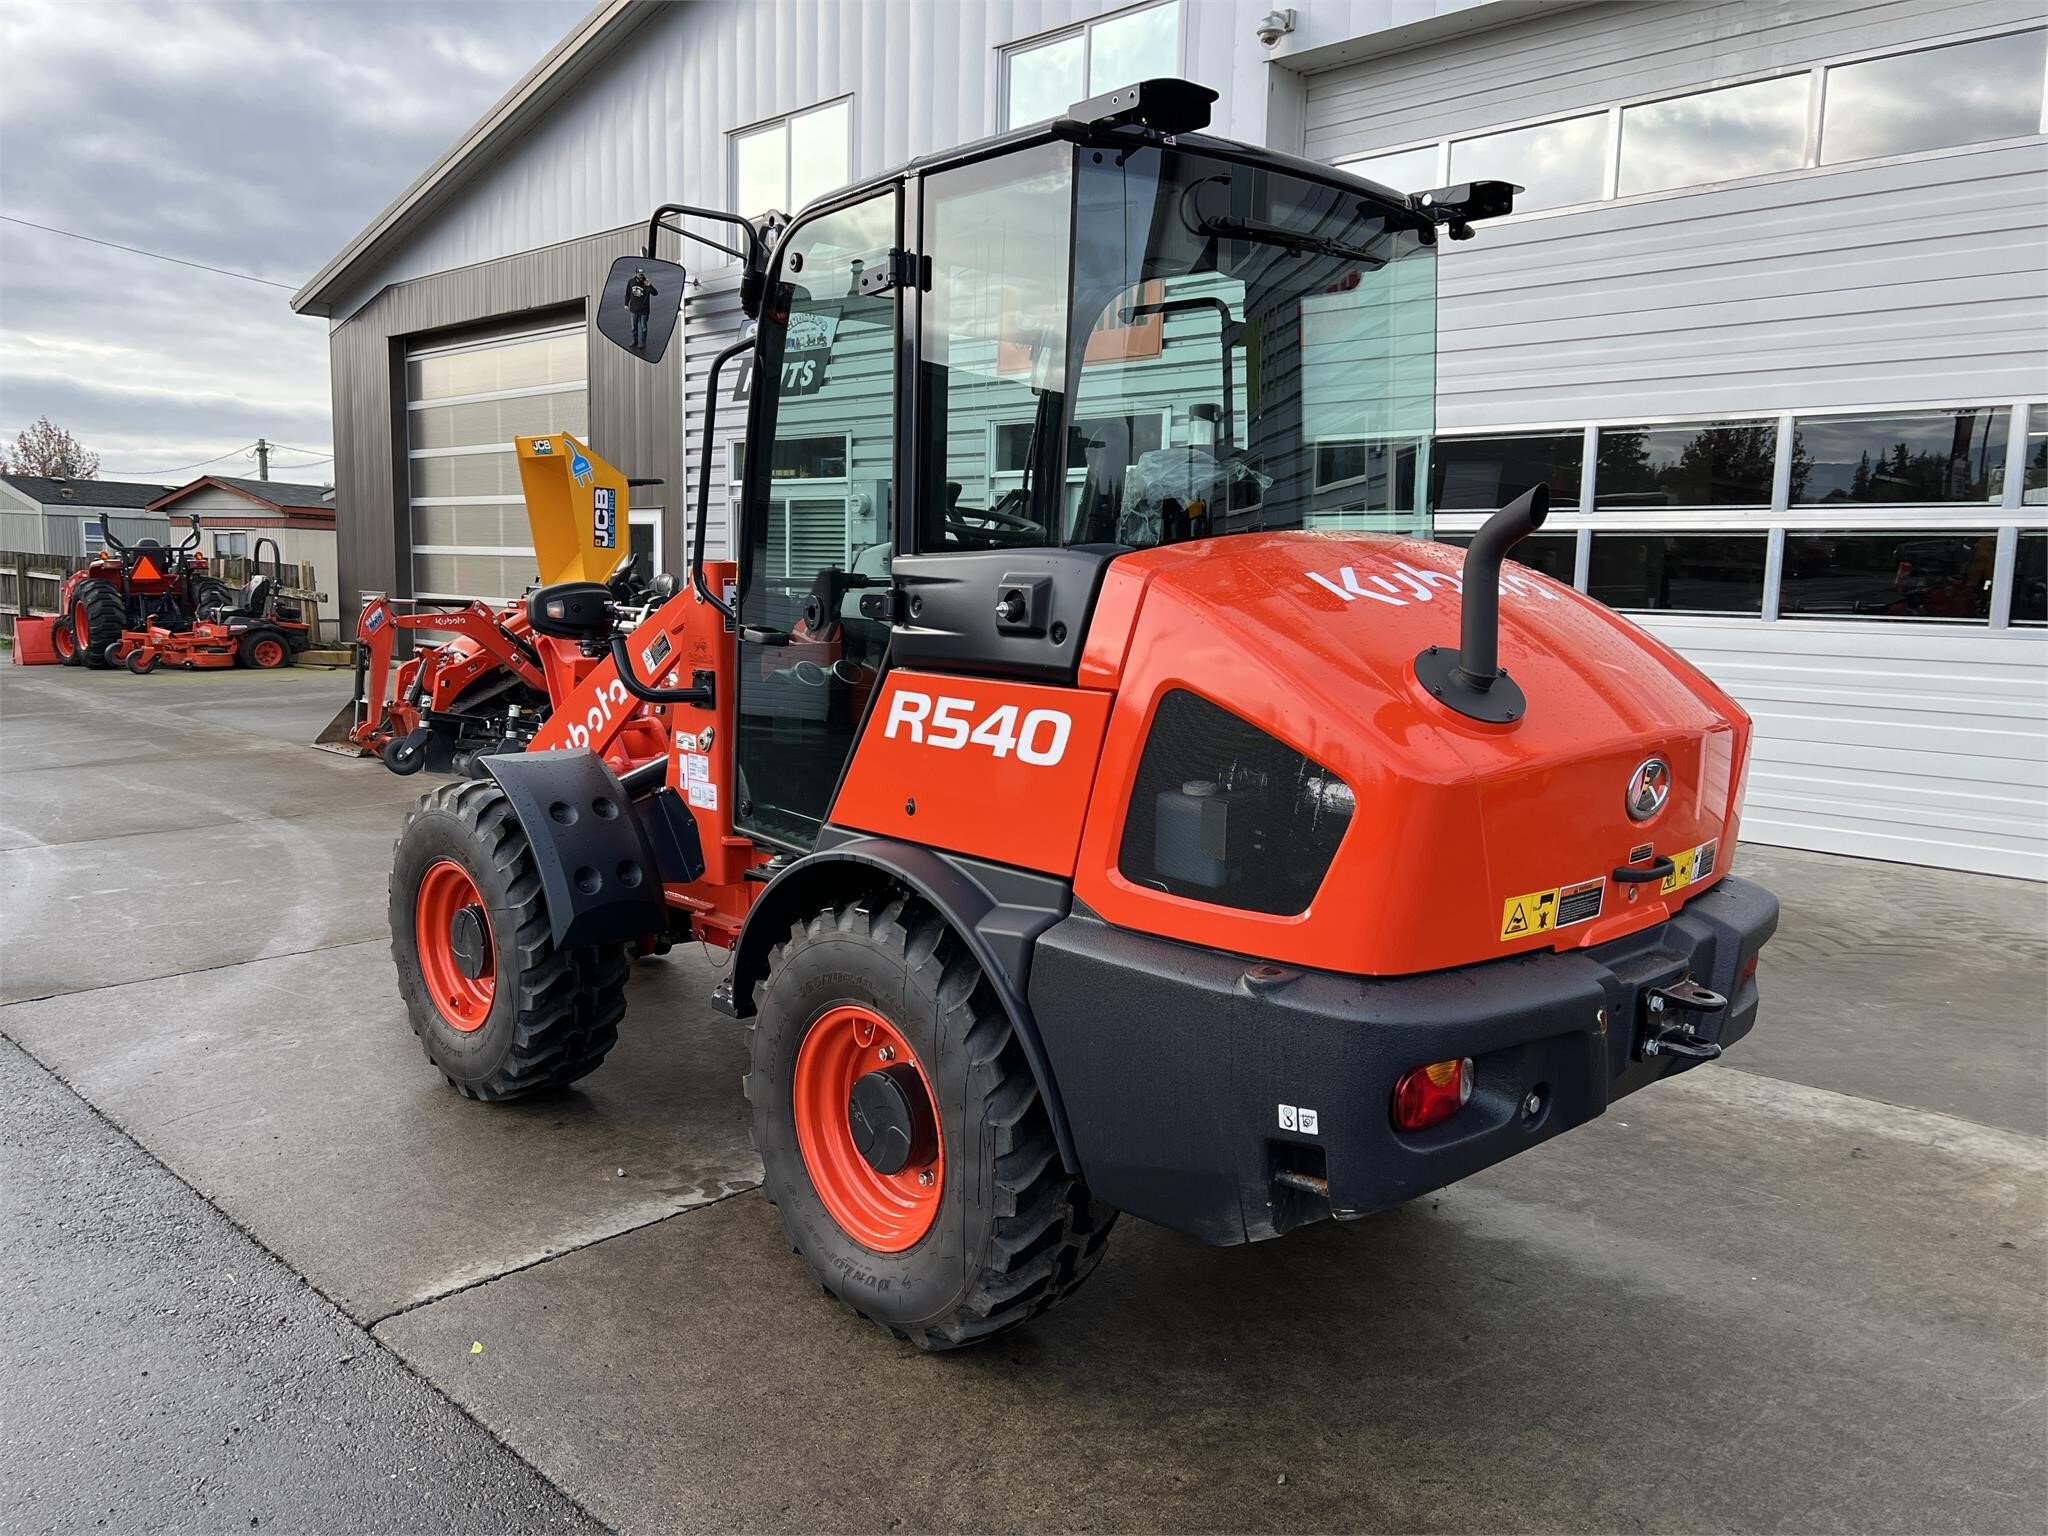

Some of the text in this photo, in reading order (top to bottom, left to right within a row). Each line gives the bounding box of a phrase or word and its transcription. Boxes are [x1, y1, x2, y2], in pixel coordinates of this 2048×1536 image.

[533, 439, 552, 450] JCB
[595, 488, 609, 547] JCB
[435, 616, 466, 626] Kubota
[884, 689, 1072, 767] R540
